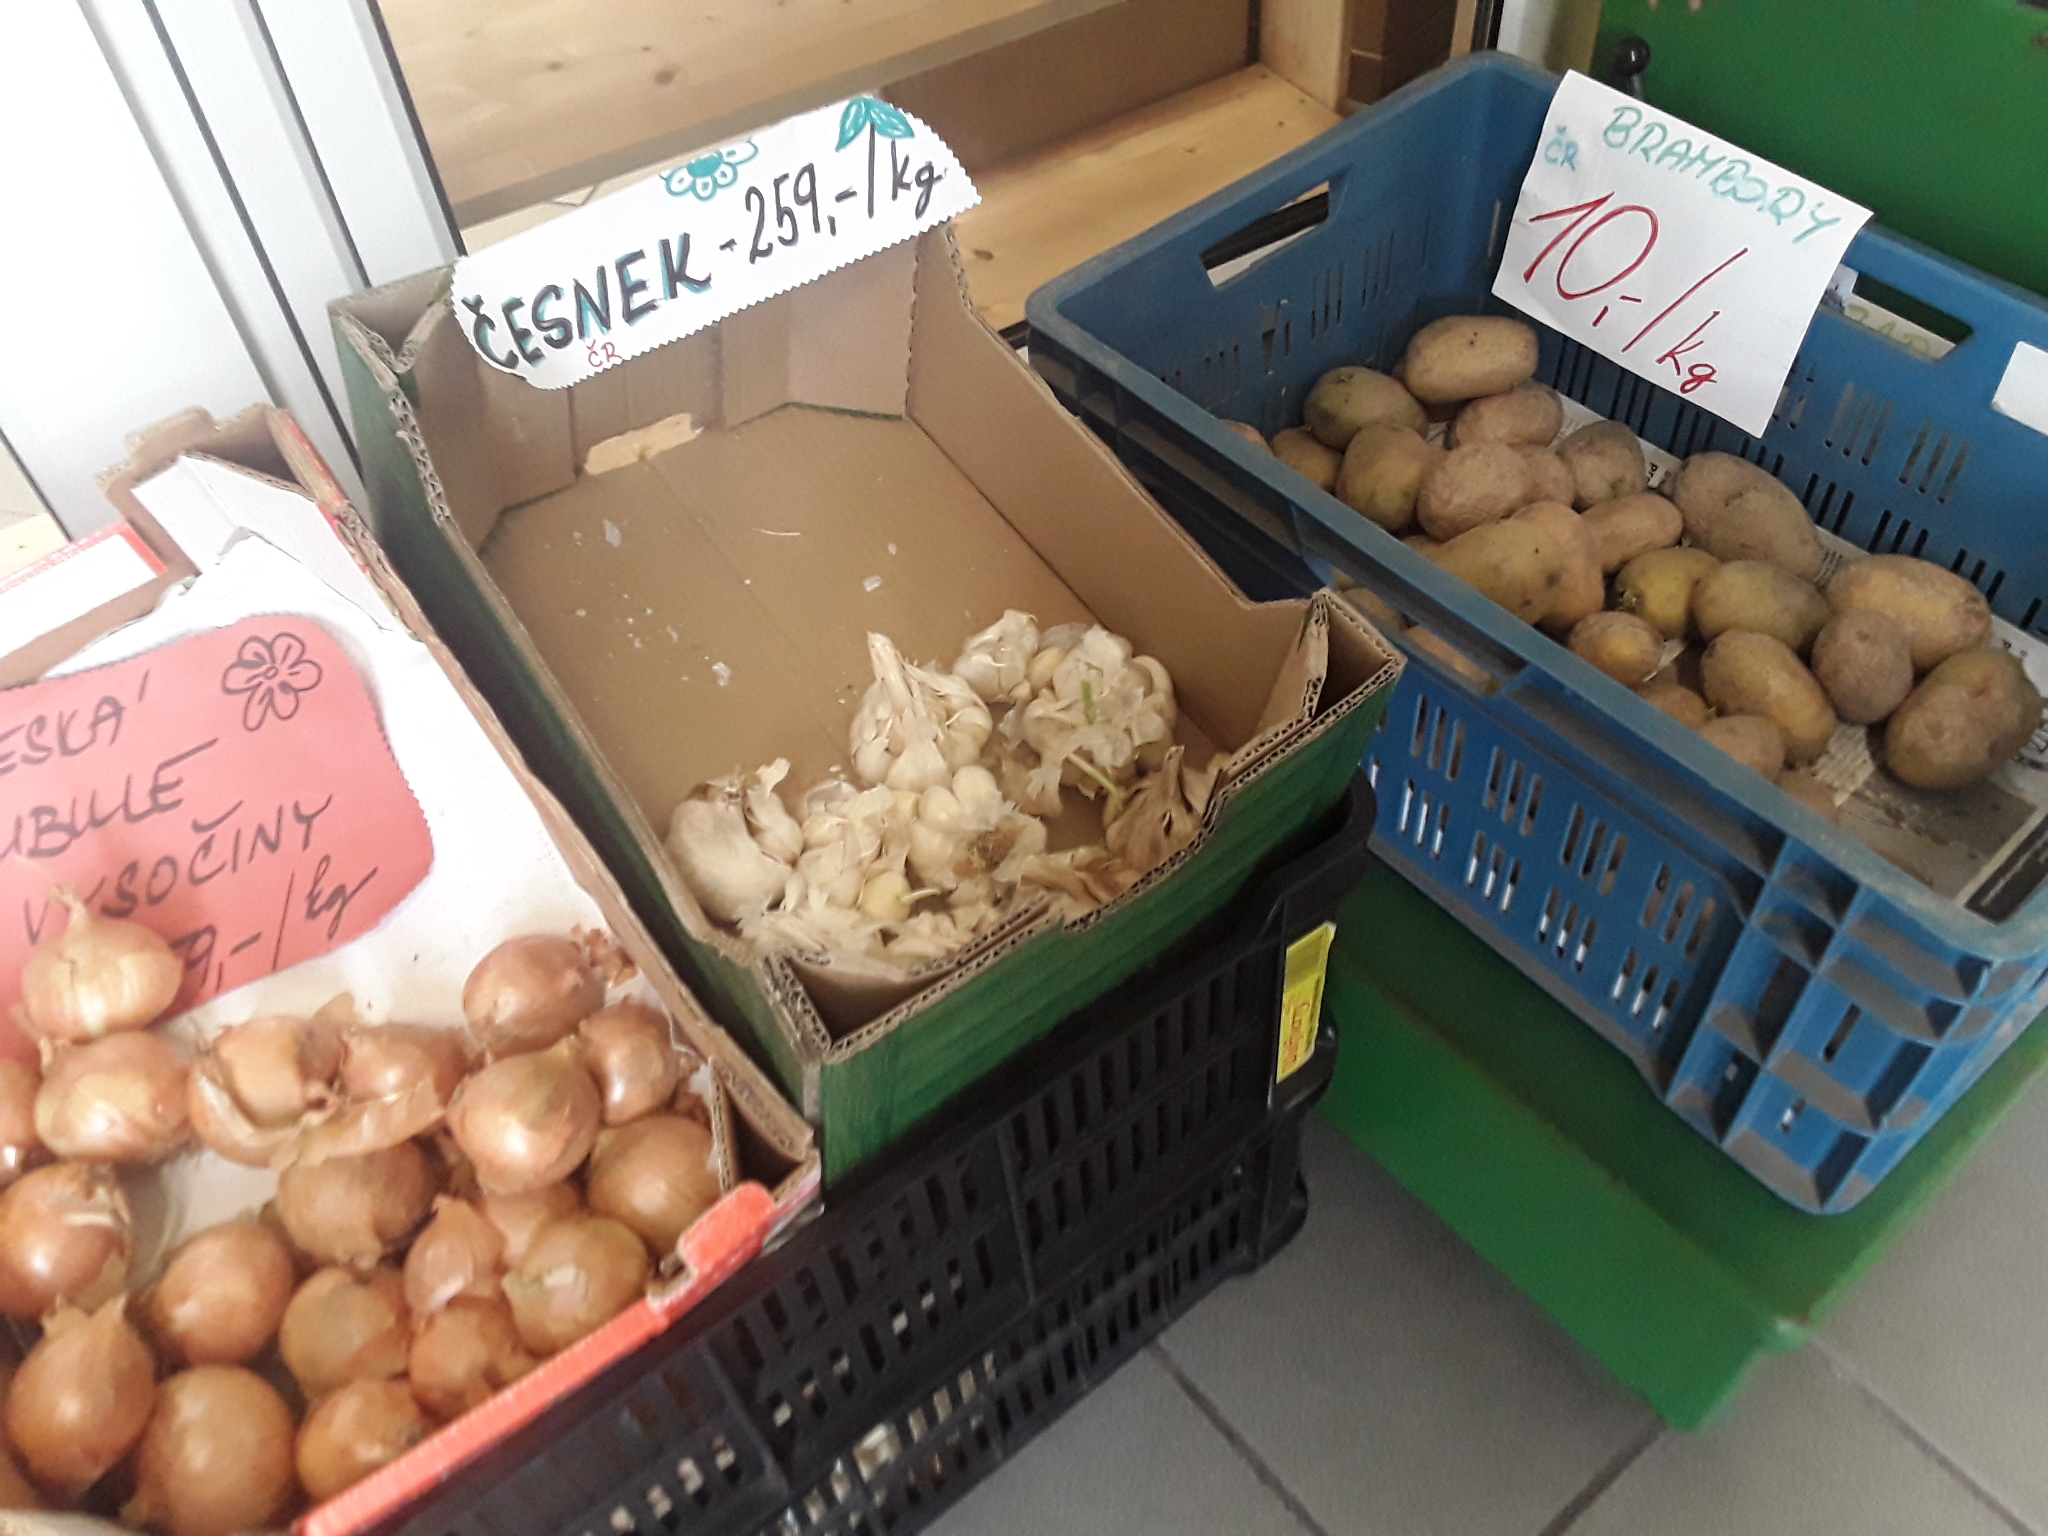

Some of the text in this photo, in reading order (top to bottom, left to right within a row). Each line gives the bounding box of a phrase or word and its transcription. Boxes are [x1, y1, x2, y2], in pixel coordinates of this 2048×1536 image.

[1544, 126, 1579, 171] ČR
[1603, 106, 1841, 244] BRAMBORY
[460, 231, 712, 370] ČESNEK
[587, 339, 623, 368] ČR
[0, 737, 219, 862] IBULE
